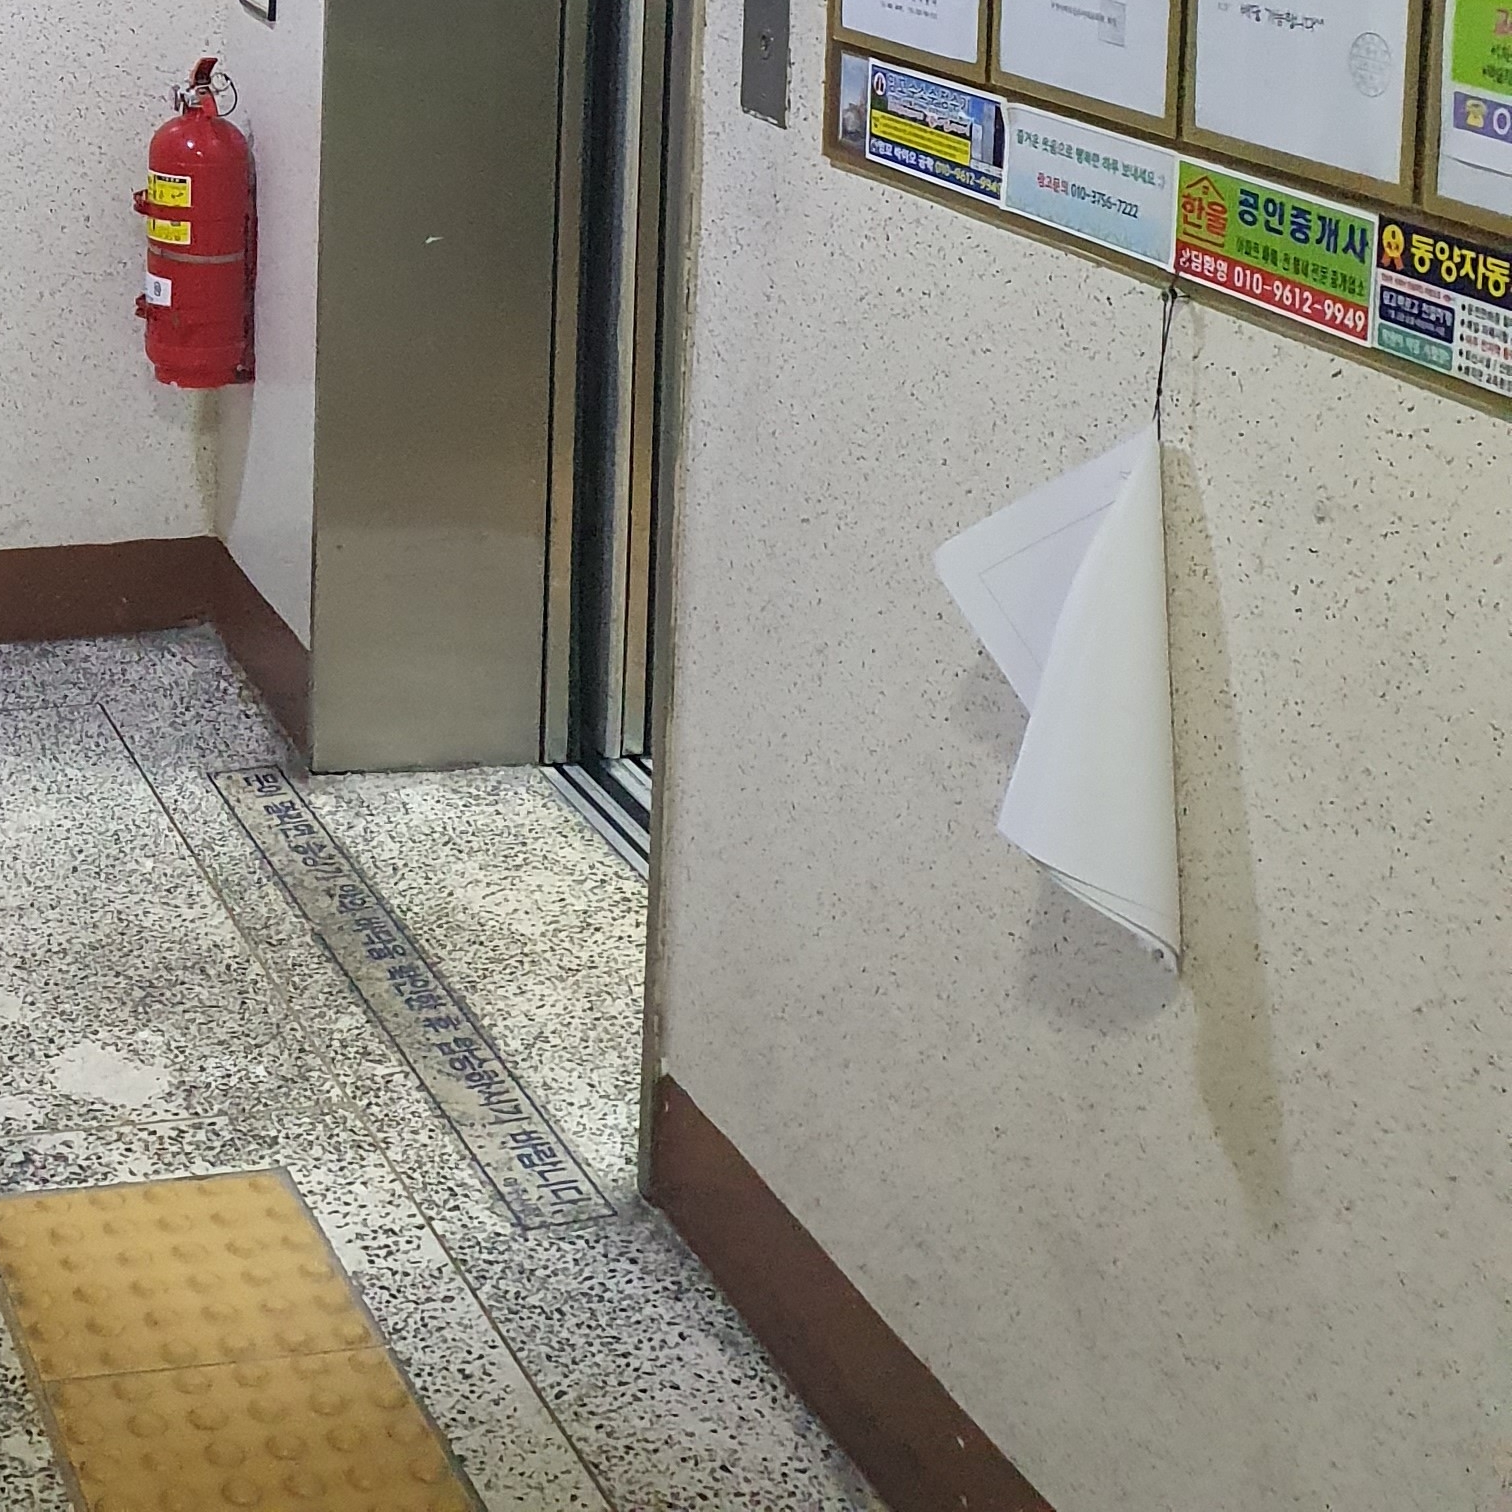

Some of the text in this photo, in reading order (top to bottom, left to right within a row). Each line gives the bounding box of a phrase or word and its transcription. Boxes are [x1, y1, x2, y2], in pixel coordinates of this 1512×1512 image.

[1181, 192, 1228, 238] 한울
[1238, 188, 1369, 265] 공인중개사
[1234, 266, 1366, 332] 010-9612-9949
